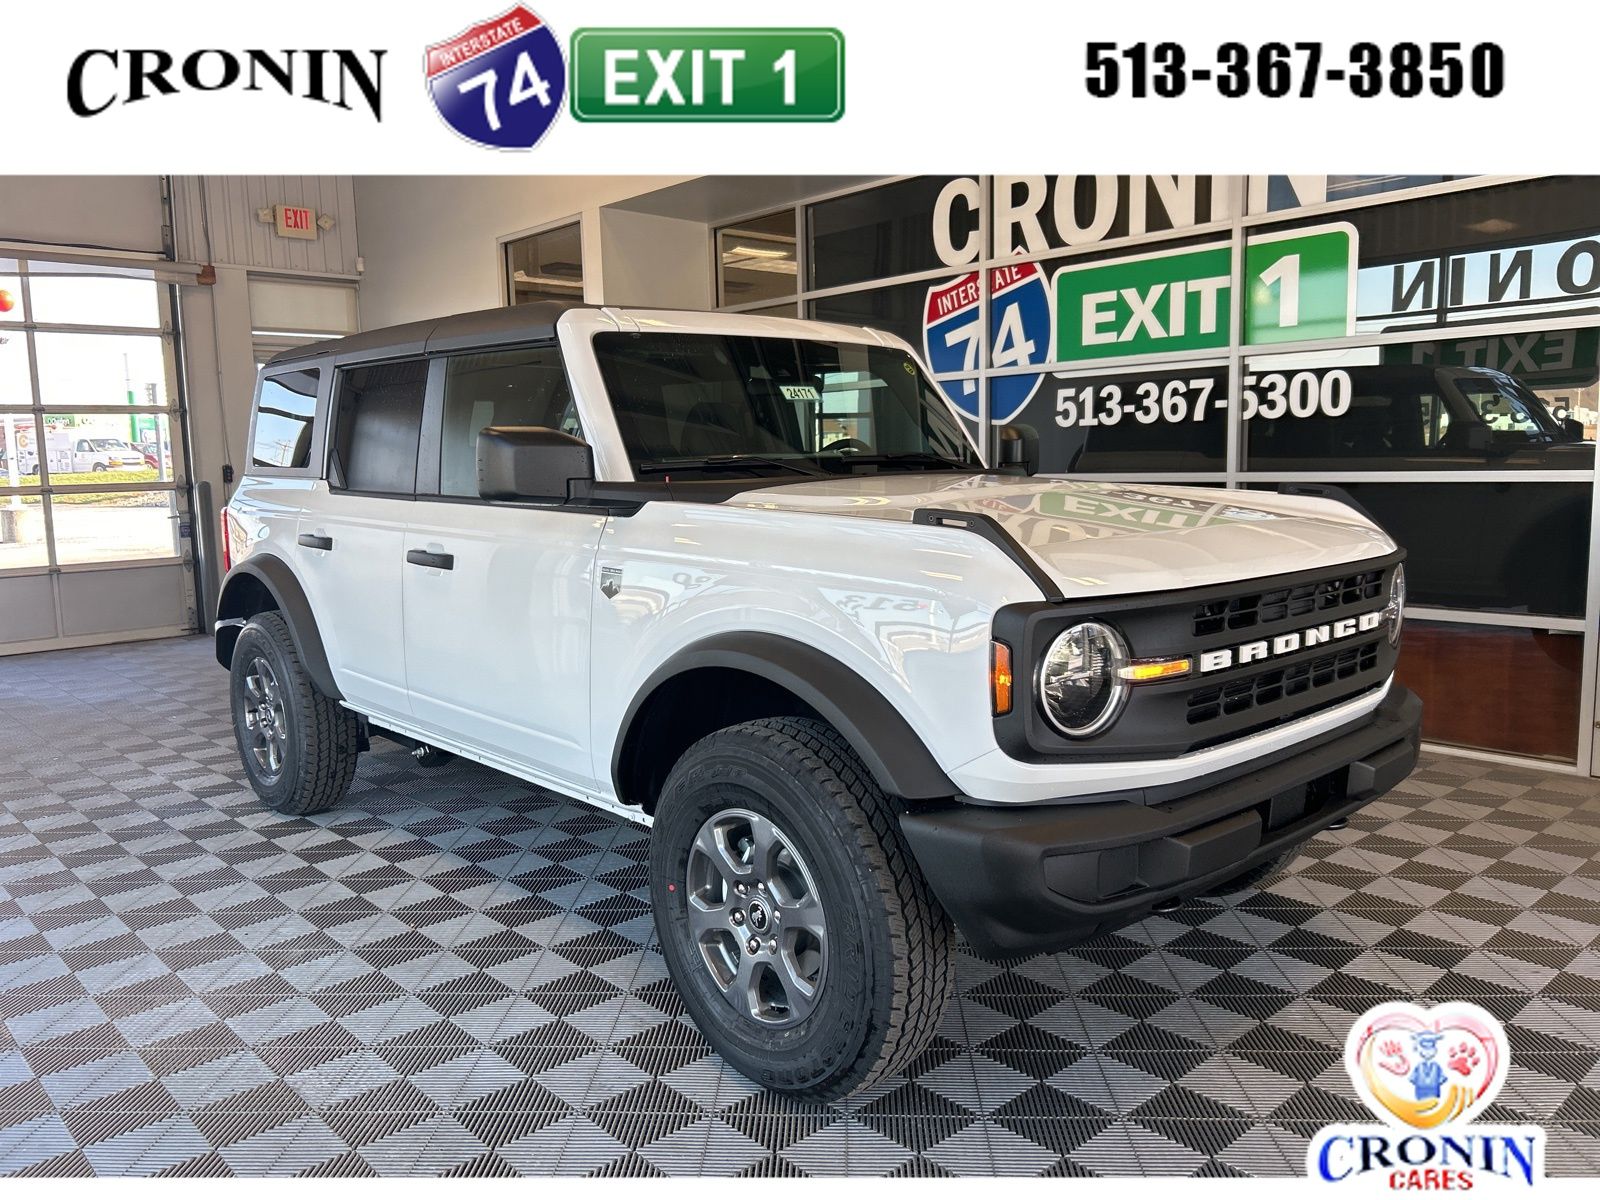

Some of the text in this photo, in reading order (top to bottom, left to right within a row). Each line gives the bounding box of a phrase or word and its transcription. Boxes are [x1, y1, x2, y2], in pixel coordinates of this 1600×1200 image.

[284, 207, 310, 230] EXIT
[937, 266, 1022, 316] INTERATE
[1082, 253, 1300, 346] EXIT 1
[944, 302, 1036, 396] 74
[786, 387, 814, 400] 24171
[1055, 369, 1352, 428] 513-367-5300
[1200, 611, 1380, 673] BRONCO
